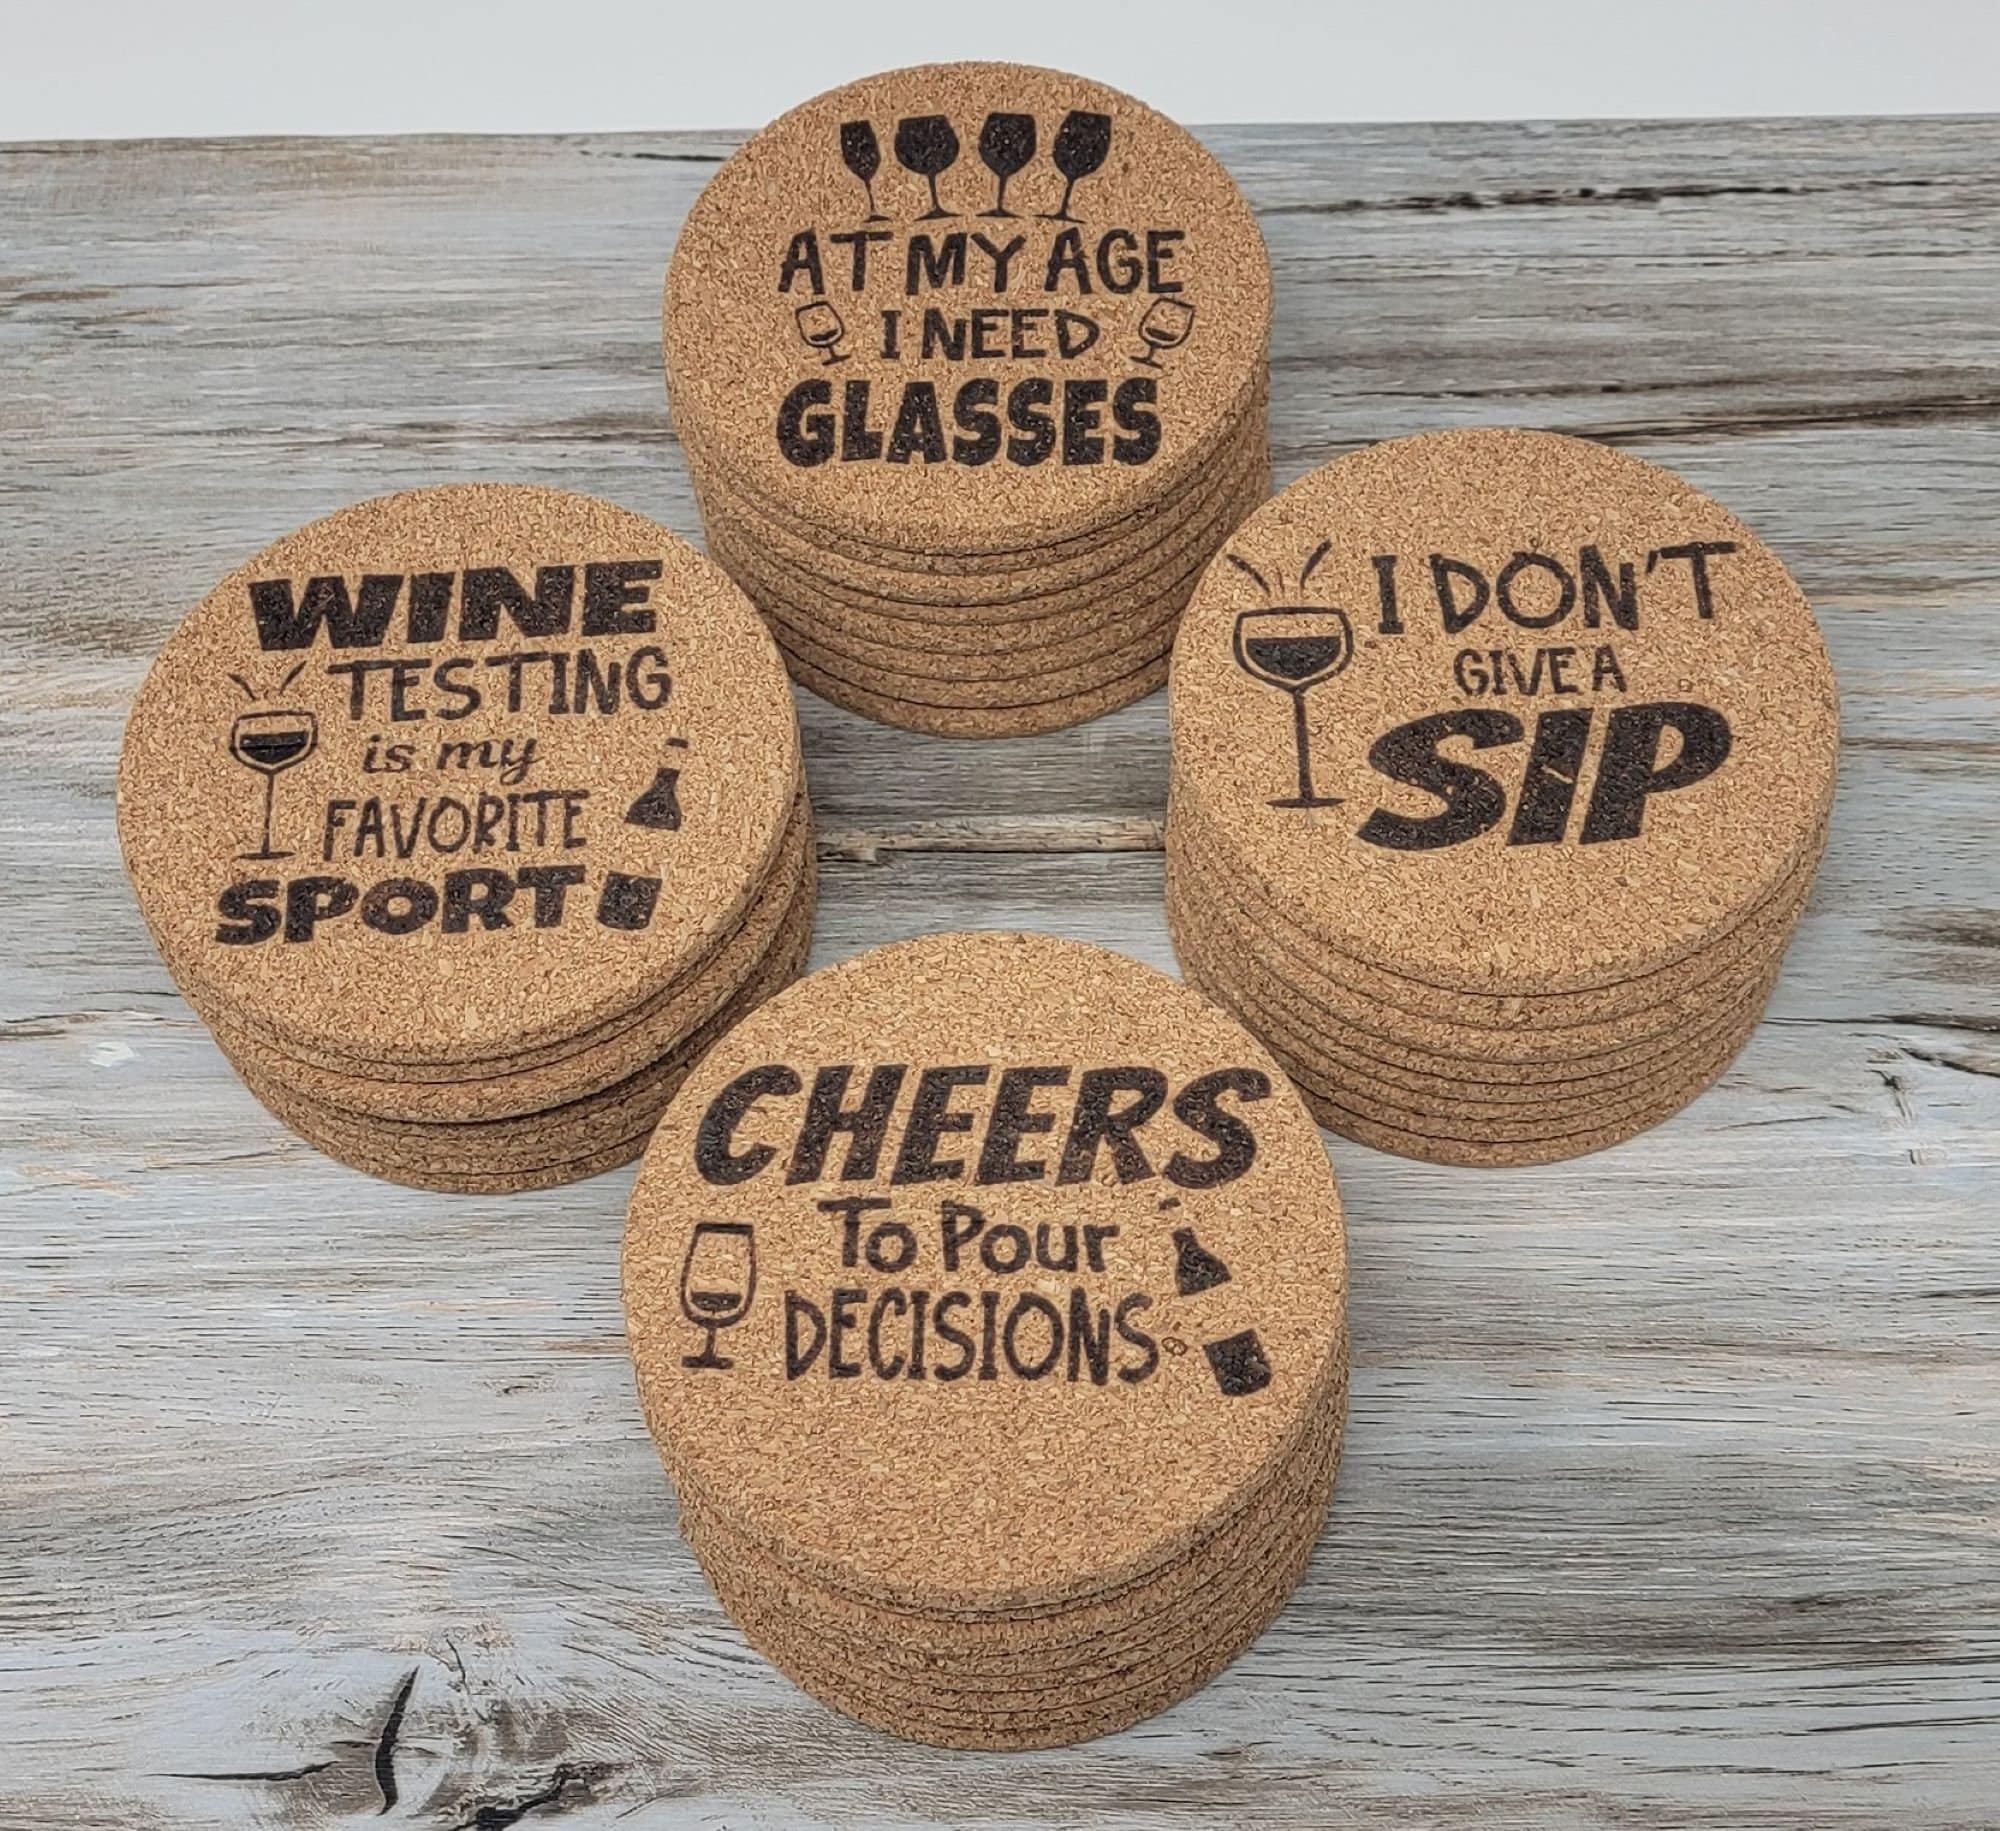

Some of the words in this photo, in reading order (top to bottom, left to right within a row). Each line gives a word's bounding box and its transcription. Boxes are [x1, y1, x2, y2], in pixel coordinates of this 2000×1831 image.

[777, 228, 895, 296] AT
[905, 232, 1027, 296] MY
[1043, 227, 1186, 295] AGE
[880, 309, 903, 361] I
[921, 307, 1101, 362] NEED
[776, 377, 1163, 468] GLASSES
[247, 559, 664, 652] WINE
[1370, 554, 1405, 636] I
[1428, 540, 1738, 635] DON'T
[326, 646, 673, 723] TESTING
[1453, 647, 1580, 697] GIVE
[1590, 644, 1629, 694] A
[362, 733, 418, 775] is
[435, 736, 541, 786] my
[1355, 701, 1735, 852] SIP
[322, 789, 592, 862] FAVORITE
[214, 865, 587, 947] SPORT
[693, 1063, 1272, 1190] CHEERS
[816, 1196, 920, 1273] To
[940, 1199, 1121, 1275] Pour
[783, 1286, 1161, 1386] DECISIONS
